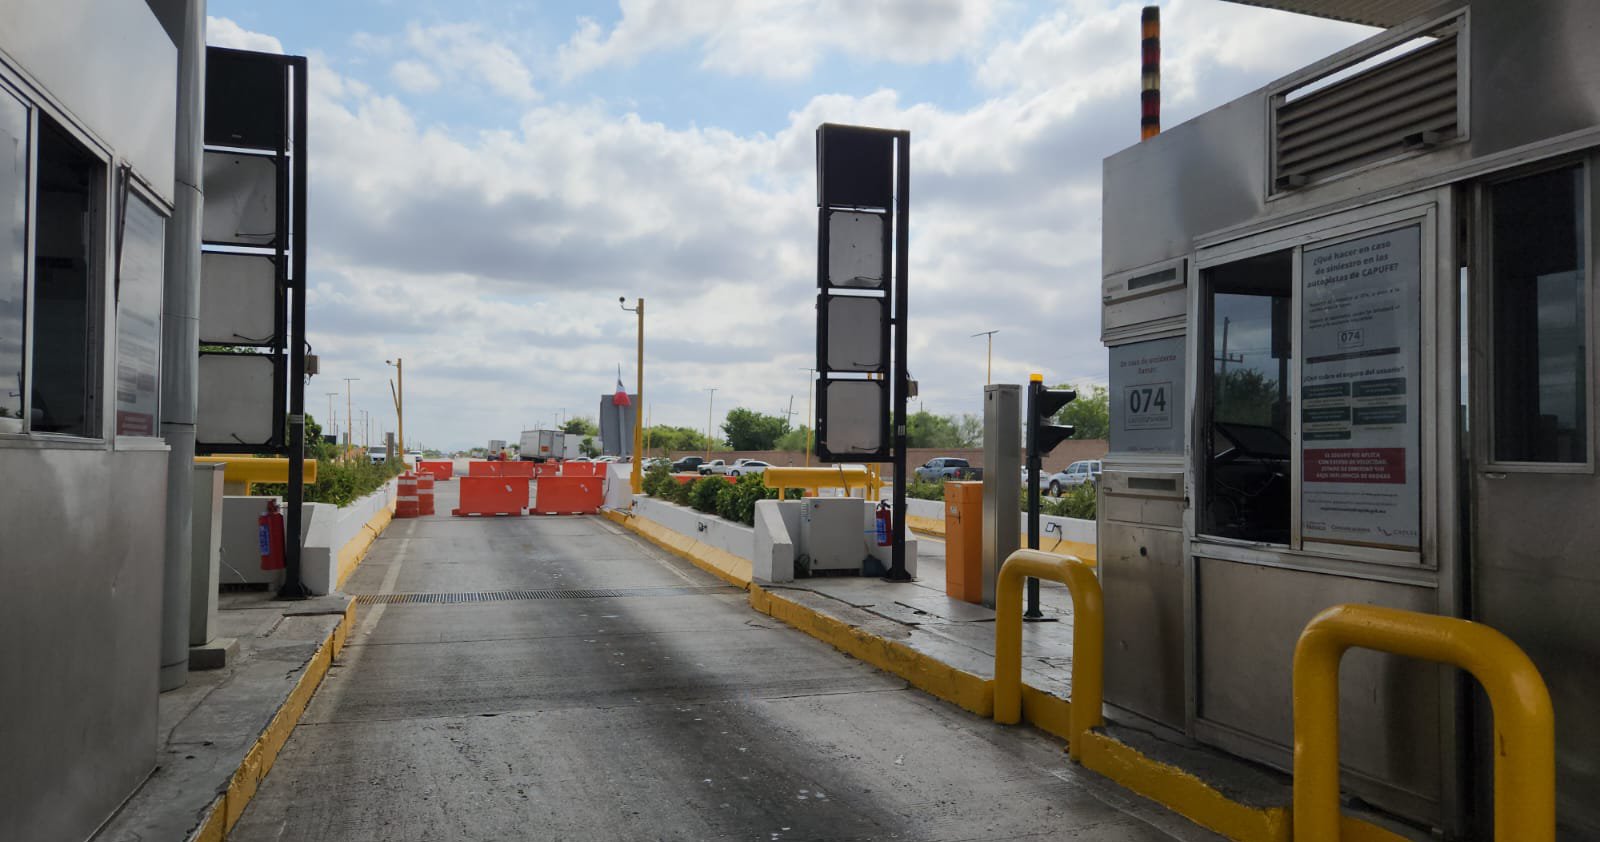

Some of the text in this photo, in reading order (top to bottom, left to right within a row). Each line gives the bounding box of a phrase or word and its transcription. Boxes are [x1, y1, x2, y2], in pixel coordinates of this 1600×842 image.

[1334, 249, 1357, 260] hacer
[1360, 246, 1370, 254] en
[1371, 241, 1391, 251] caso
[1326, 260, 1361, 273] siniestro
[1363, 256, 1374, 264] en
[1376, 254, 1388, 262] las
[1307, 262, 1399, 288] autopistas de CAPUFE?
[1340, 331, 1360, 342] 074
[1130, 387, 1166, 414] 074
